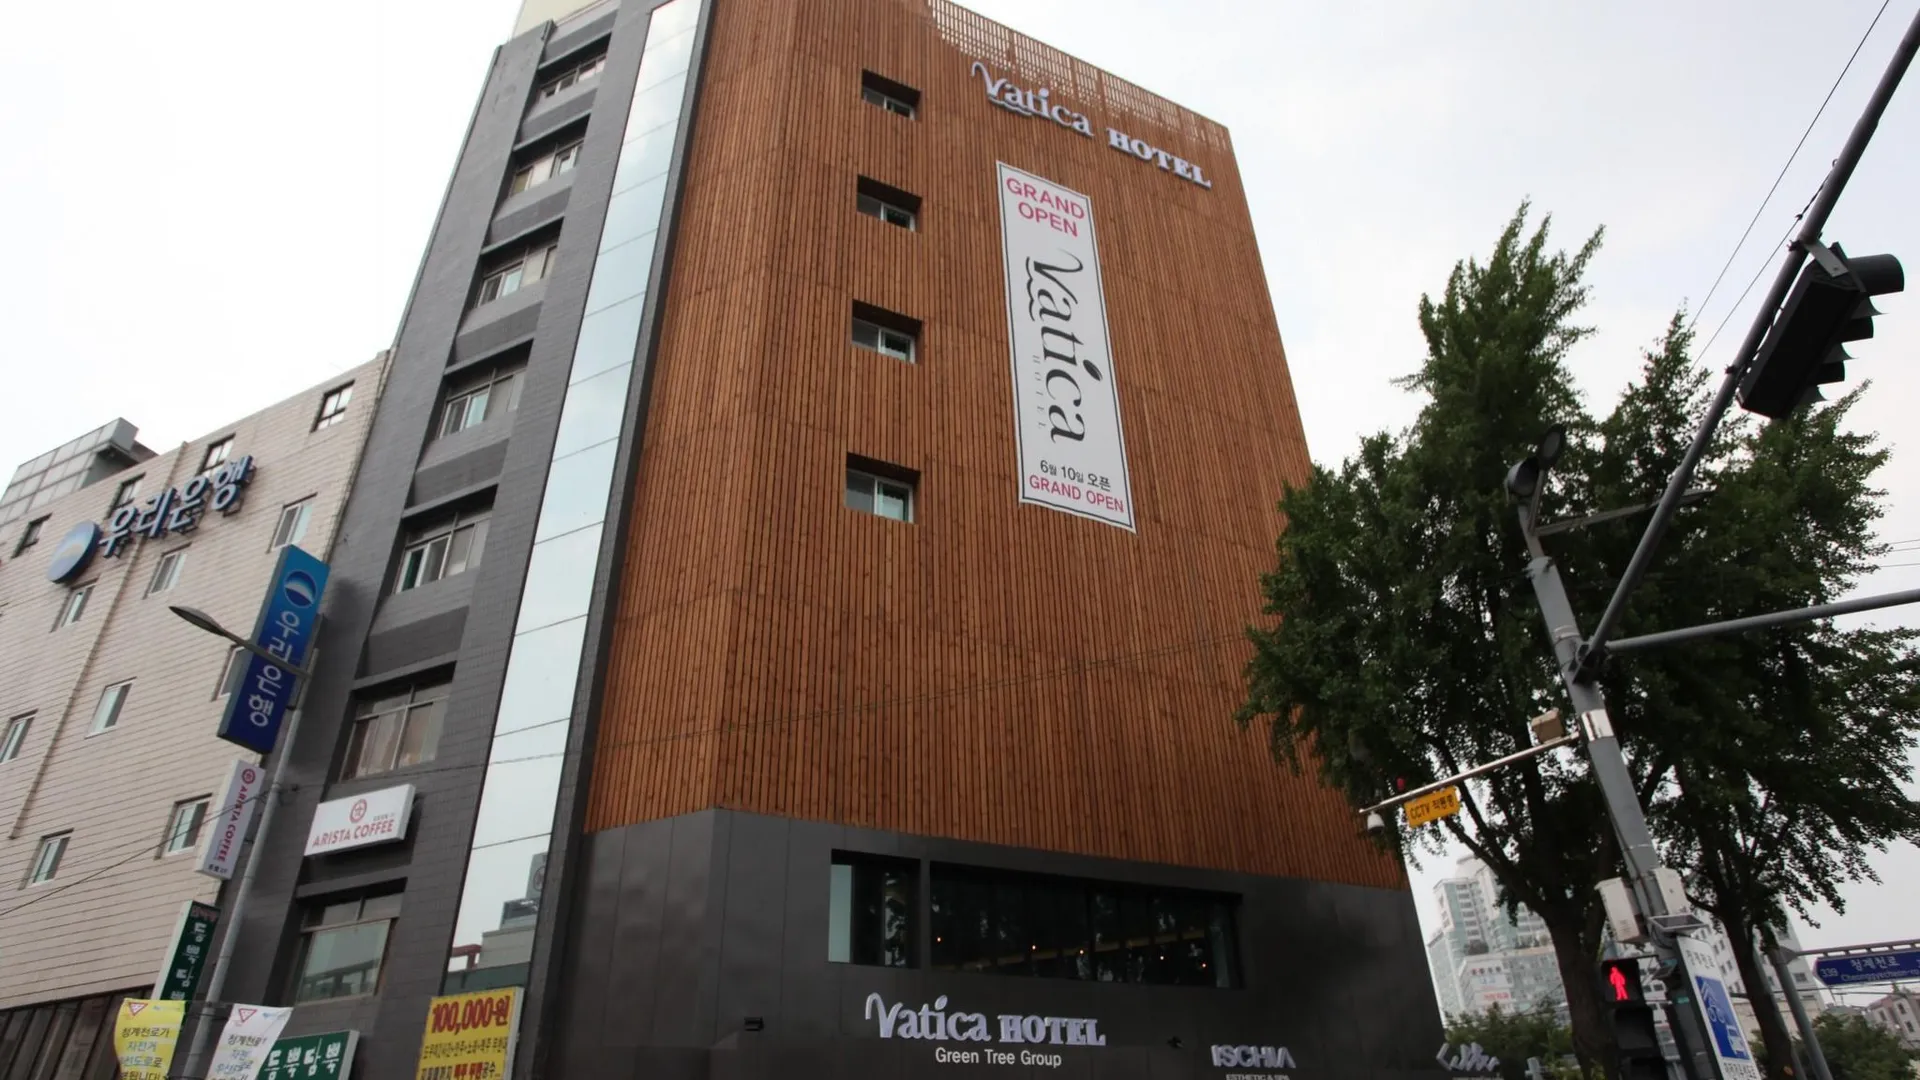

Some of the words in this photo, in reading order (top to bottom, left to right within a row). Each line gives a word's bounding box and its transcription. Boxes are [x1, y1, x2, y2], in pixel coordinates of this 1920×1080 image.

[971, 61, 1094, 137] Vatica
[1106, 127, 1212, 189] HOTEL
[1006, 177, 1085, 220] GRAND
[1018, 201, 1078, 238] OPEN
[1026, 248, 1103, 444] Vatica
[1029, 474, 1081, 500] GRAND
[1086, 490, 1124, 513] OPEN
[1040, 459, 1057, 476] 6월
[1061, 466, 1084, 484] 10일
[1087, 472, 1111, 492] 오픈
[98, 455, 254, 558] 우리은행
[247, 610, 300, 728] 우리은행
[231, 785, 248, 822] ARISTA
[1410, 803, 1430, 819] CCTV
[218, 824, 236, 862] COFFEE
[312, 828, 351, 848] ARISTA
[354, 819, 395, 840] COFFEE
[1850, 956, 1900, 972] 청계천로
[432, 995, 510, 1035] 100,000원
[865, 992, 992, 1042] Vatica
[997, 1014, 1106, 1046] HOTEL
[935, 1047, 980, 1064] Green
[984, 1048, 1016, 1065] Tree
[1020, 1050, 1062, 1069] Group
